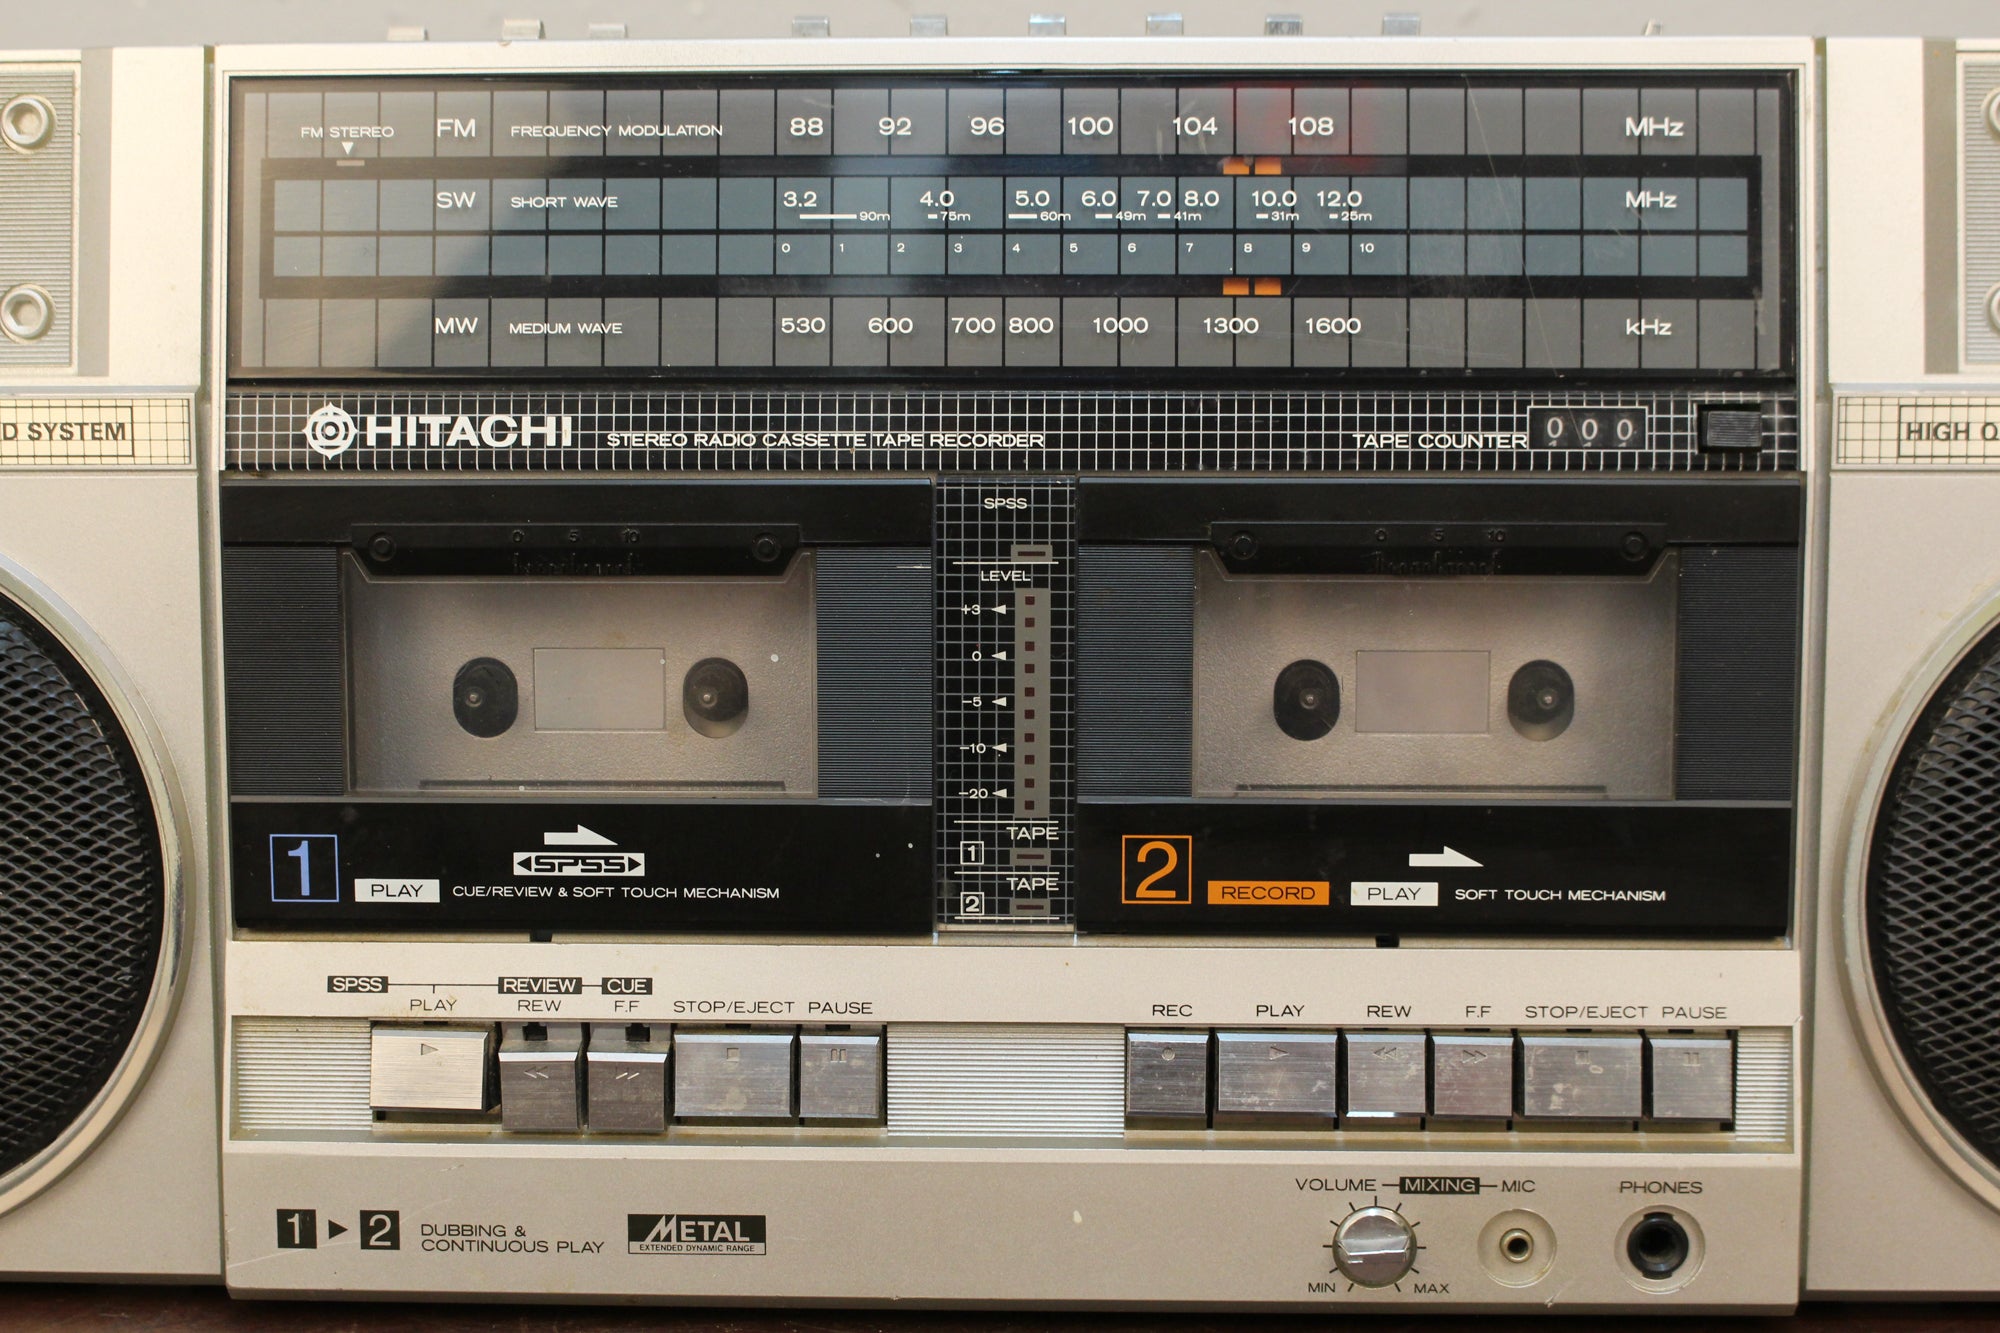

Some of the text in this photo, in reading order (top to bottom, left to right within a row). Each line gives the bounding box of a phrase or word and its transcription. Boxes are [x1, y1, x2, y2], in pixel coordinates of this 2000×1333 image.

[301, 127, 395, 139] FM STEREO
[436, 118, 477, 139] FM
[510, 124, 724, 138] FREQUENCY MODULATION
[789, 117, 1334, 136] 88 92 96 100 104 108
[1625, 117, 1684, 137] MHz
[436, 191, 476, 209] SW
[510, 196, 618, 208] SHORT WAVE
[783, 190, 1362, 207] 3.2 4.0 5.0 6.0 7.0 8.0 10.0 12.0
[1625, 190, 1678, 208] MHz
[859, 211, 891, 222] 90m
[940, 211, 971, 222] 75m
[1040, 211, 1071, 222] 60m
[1115, 211, 1146, 222] 49m
[1173, 211, 1202, 222] 41m
[1271, 211, 1299, 222] 31m
[1341, 211, 1372, 222] 25m
[781, 243, 1375, 253] 0 1 2 3 4 5 6 7 8 9 10
[434, 317, 479, 335] MW
[509, 322, 623, 335] MEDIUM WAVE
[781, 317, 1362, 334] 530 600 700 800 1000 1300 1600
[1625, 318, 1672, 336] kHz
[27, 422, 126, 441] SYSTEM
[366, 415, 572, 447] HITACHI
[1906, 422, 1970, 442] HIGH
[606, 433, 1045, 448] STEREO RADIO CASSETTE TAPE RECORDER
[1352, 434, 1527, 449] TAPE COUNTER
[983, 497, 1028, 510] SPSS
[981, 570, 1031, 582] LEVEL
[961, 604, 981, 616] +3
[971, 651, 982, 662] 0
[1006, 826, 1059, 840] TAPE
[967, 845, 977, 862] 1
[288, 839, 309, 897] 1
[533, 855, 627, 874] SPSS
[1136, 841, 1178, 899] 2
[370, 884, 424, 898] PLAY
[1006, 877, 1059, 891] TAPE
[453, 885, 780, 900] CUE/REVIEW & SOFT TOUCH MECHANISM
[1221, 886, 1315, 900] RECORD
[1367, 887, 1421, 901] PLAY
[1454, 889, 1667, 901] SOFT TOUCH MECHANISM
[965, 895, 980, 912] 2
[333, 978, 382, 992] SPSS
[503, 978, 577, 993] REVIEW
[606, 979, 649, 994] CUE
[410, 999, 457, 1011] PLAY
[517, 1000, 562, 1012] REW
[614, 1000, 640, 1013] F.F
[673, 1001, 795, 1014] STOP/EJECT
[808, 1002, 873, 1014] PAUSE
[1152, 1005, 1193, 1018] REC
[1255, 1005, 1306, 1018] PLAY
[1366, 1005, 1412, 1018] REW
[1465, 1006, 1492, 1019] F.F
[1525, 1006, 1649, 1019] STOP/EJECT
[1662, 1007, 1727, 1020] PAUSE
[1296, 1178, 1377, 1192] VOLUME
[1404, 1179, 1477, 1192] MIXING
[1501, 1180, 1536, 1193] MIC
[1619, 1181, 1704, 1194] PHONES
[286, 1213, 302, 1244] 1
[369, 1214, 392, 1247] 2
[420, 1224, 527, 1238] DUBBING &
[643, 1215, 751, 1242] METAL
[420, 1239, 605, 1254] CONTINUOUS PLAY
[639, 1243, 756, 1253] EXTENDED DYNAMIC RANGE
[1307, 1282, 1336, 1293] MIN
[1414, 1283, 1451, 1294] MAX
